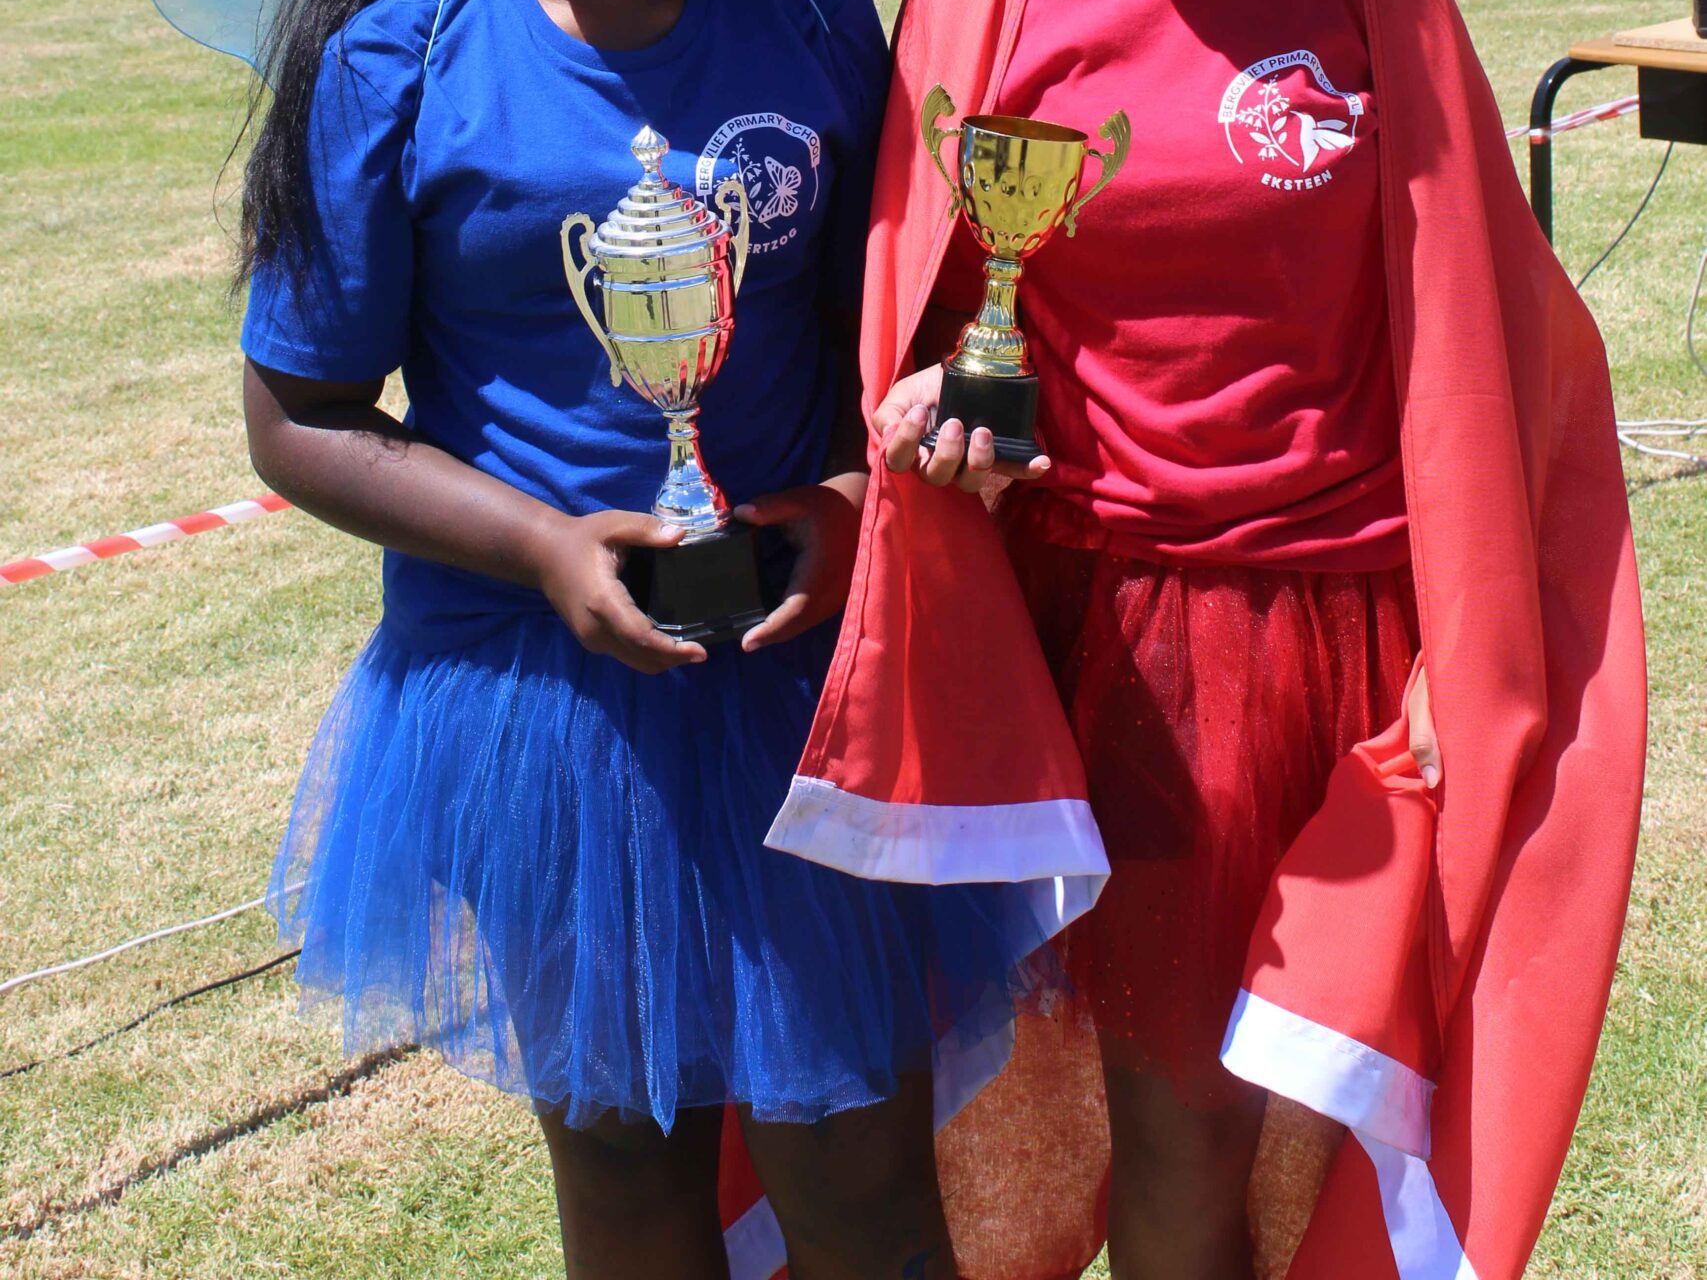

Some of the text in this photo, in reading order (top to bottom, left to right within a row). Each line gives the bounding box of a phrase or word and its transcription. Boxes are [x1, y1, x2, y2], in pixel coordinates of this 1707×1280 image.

[1268, 51, 1320, 72] PRIMARY
[699, 114, 820, 191] BERGVLIET PRIMARY SCHOOL
[1261, 169, 1333, 191] EKSTEEN
[747, 227, 797, 254] ERTZOG
